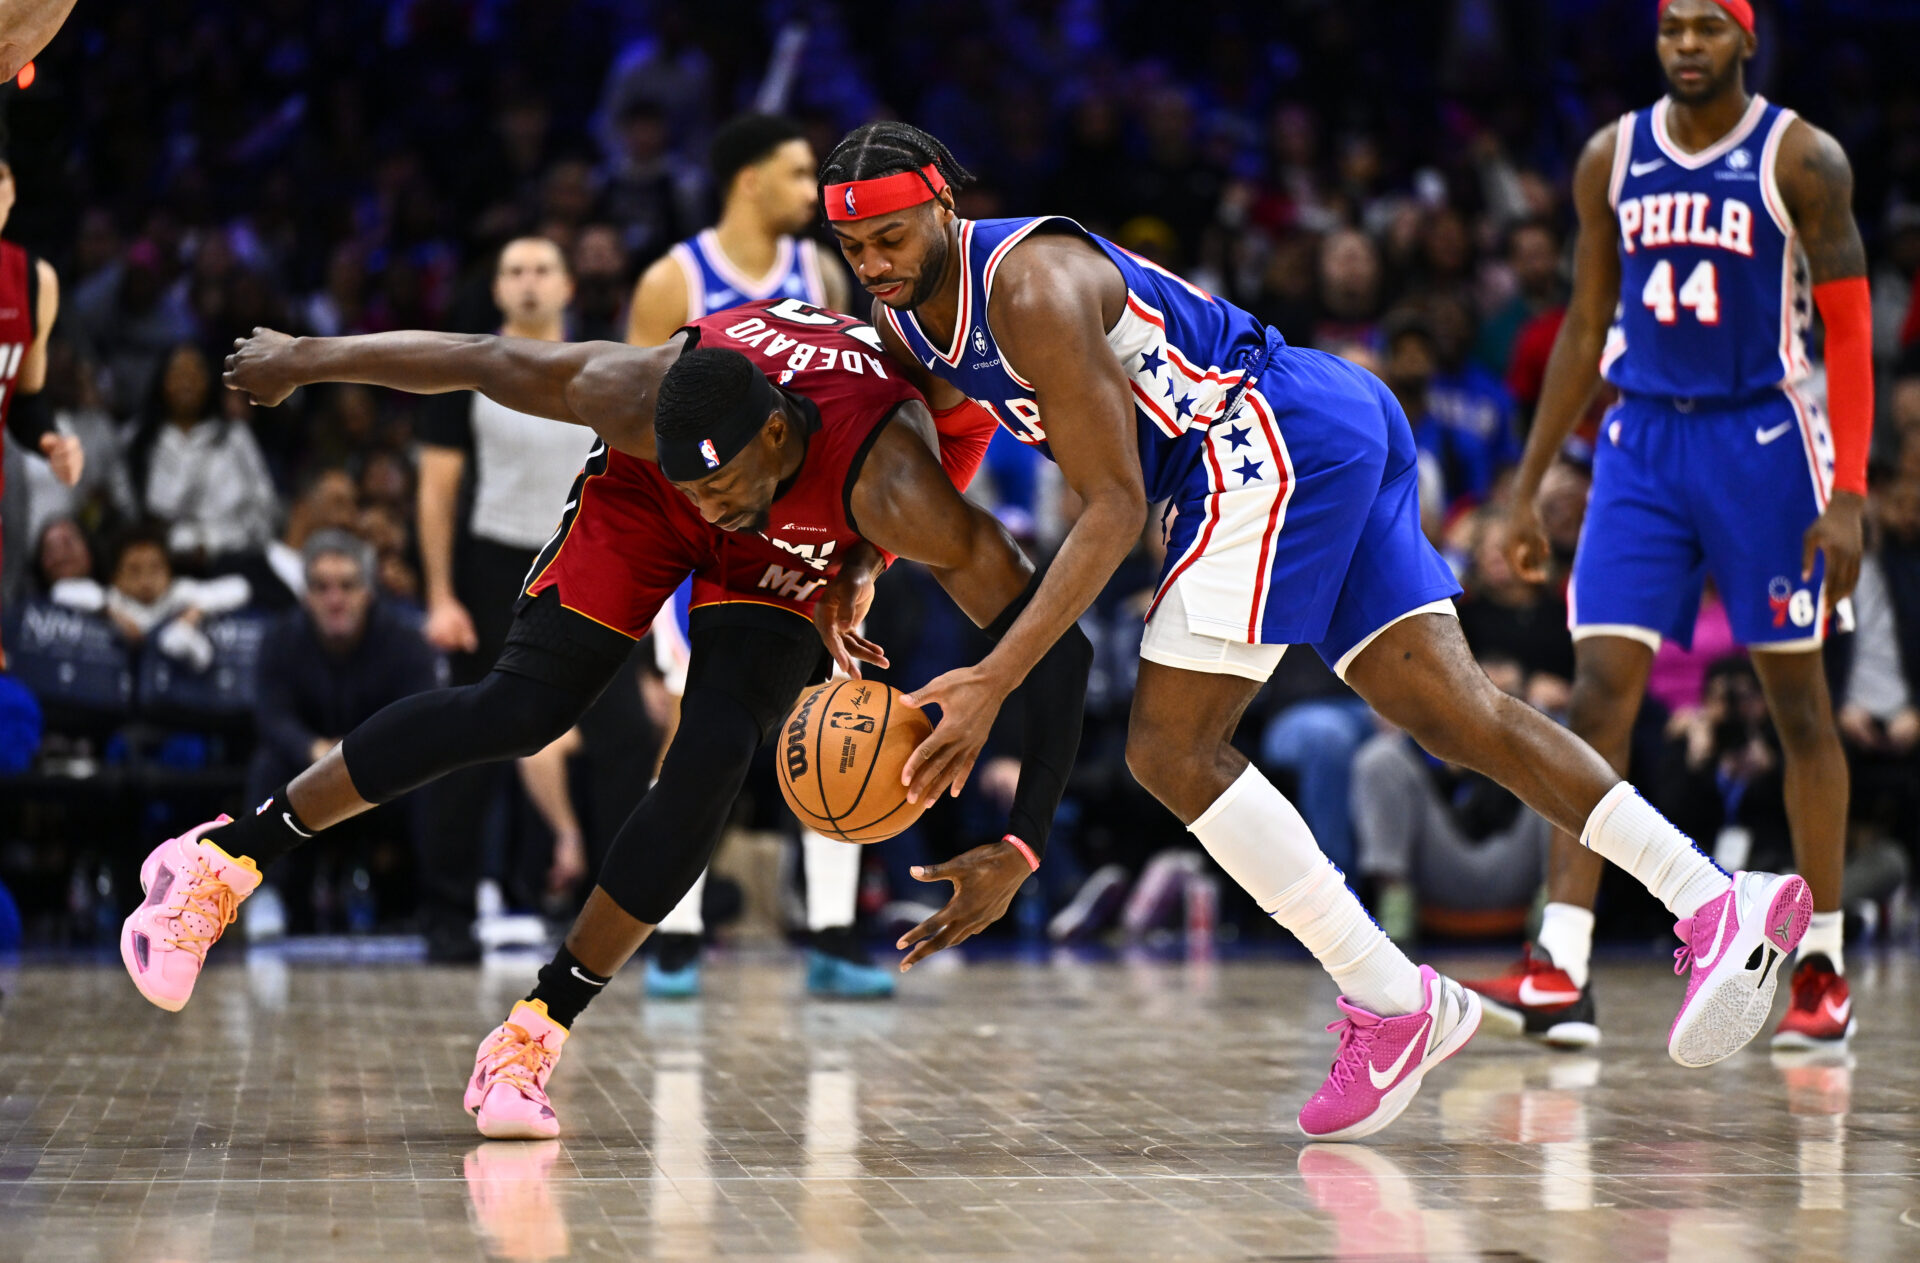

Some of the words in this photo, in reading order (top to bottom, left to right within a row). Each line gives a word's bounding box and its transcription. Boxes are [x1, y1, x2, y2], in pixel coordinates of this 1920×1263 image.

[1618, 192, 1754, 258] PHILA
[1642, 259, 1720, 326] 44
[725, 317, 889, 380] ADEBAYO
